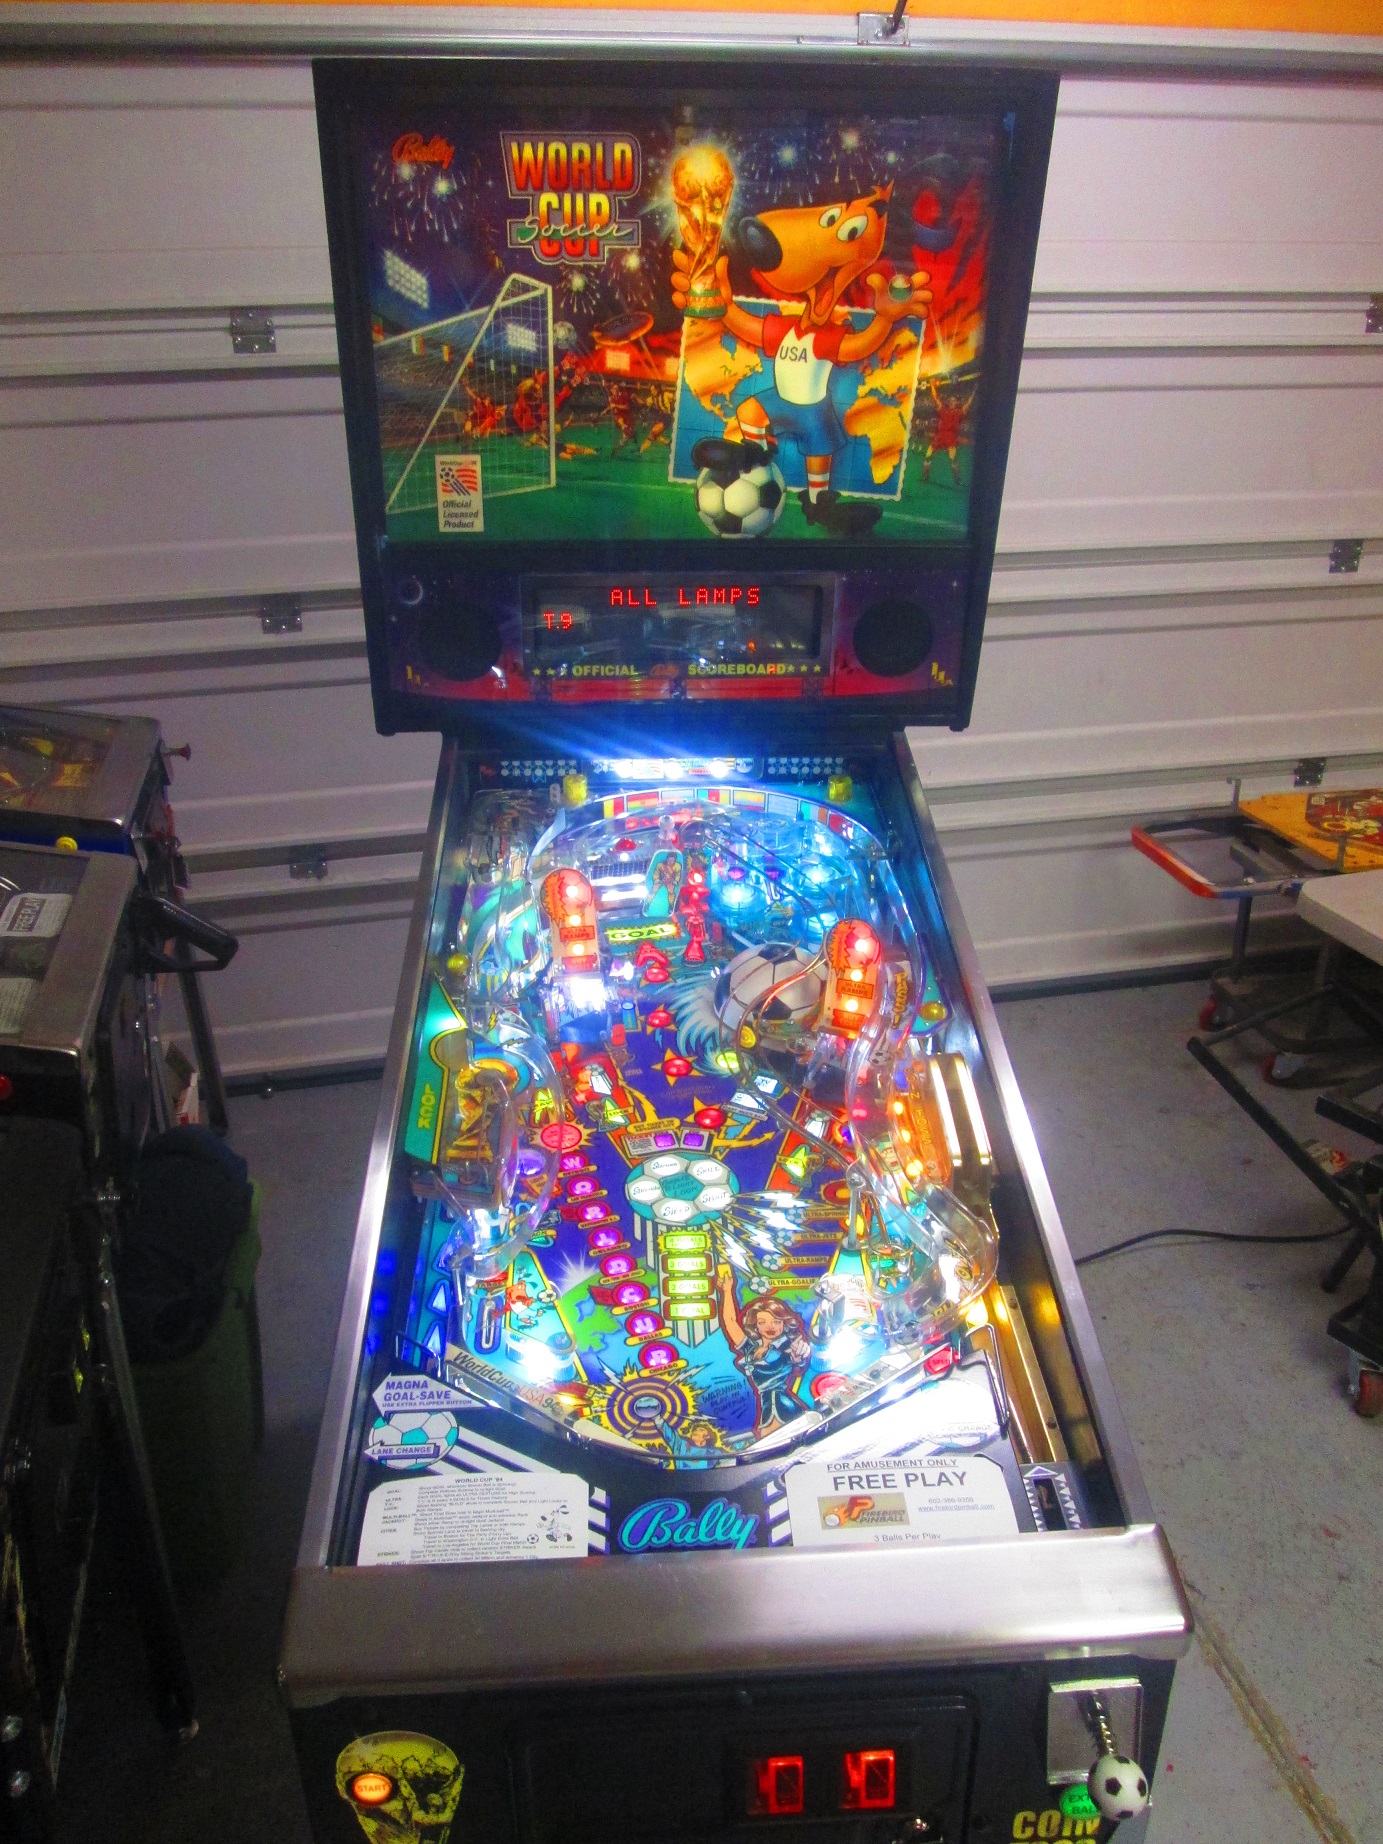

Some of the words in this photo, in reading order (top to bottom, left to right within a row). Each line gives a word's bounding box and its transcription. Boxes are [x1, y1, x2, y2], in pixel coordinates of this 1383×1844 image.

[510, 141, 634, 191] WORLD
[517, 217, 633, 243] Soccer
[538, 192, 611, 257] CUP
[780, 344, 808, 363] USA
[442, 500, 472, 508] Official
[443, 509, 479, 518] Licensed
[444, 520, 474, 529] Product
[610, 588, 657, 605] ALL
[678, 587, 760, 605] LAMPS
[572, 664, 637, 676] OFFICIAL
[687, 663, 787, 676] SCOREBOARD
[610, 925, 671, 940] GOAL
[682, 1306, 705, 1314] GAL
[638, 1332, 663, 1342] DALLAS
[648, 1363, 678, 1374] CHICAGO
[453, 1352, 513, 1389] WorldCup
[517, 1386, 545, 1406] USA
[385, 1380, 428, 1391] MAGNA
[384, 1390, 451, 1402] GOAL-SAVE
[371, 1447, 394, 1455] LANE
[396, 1446, 431, 1454] CHANGE
[827, 1462, 851, 1472] FOR
[853, 1460, 925, 1470] AMUSEMENT
[927, 1458, 958, 1468] ONLY
[833, 1473, 898, 1491] FREE
[904, 1471, 968, 1488] PLAY
[621, 1499, 756, 1550] Bally
[882, 1534, 903, 1542] Balls
[357, 1783, 387, 1793] START
[1068, 1793, 1090, 1802] EXT
[1072, 1806, 1095, 1815] BAL
